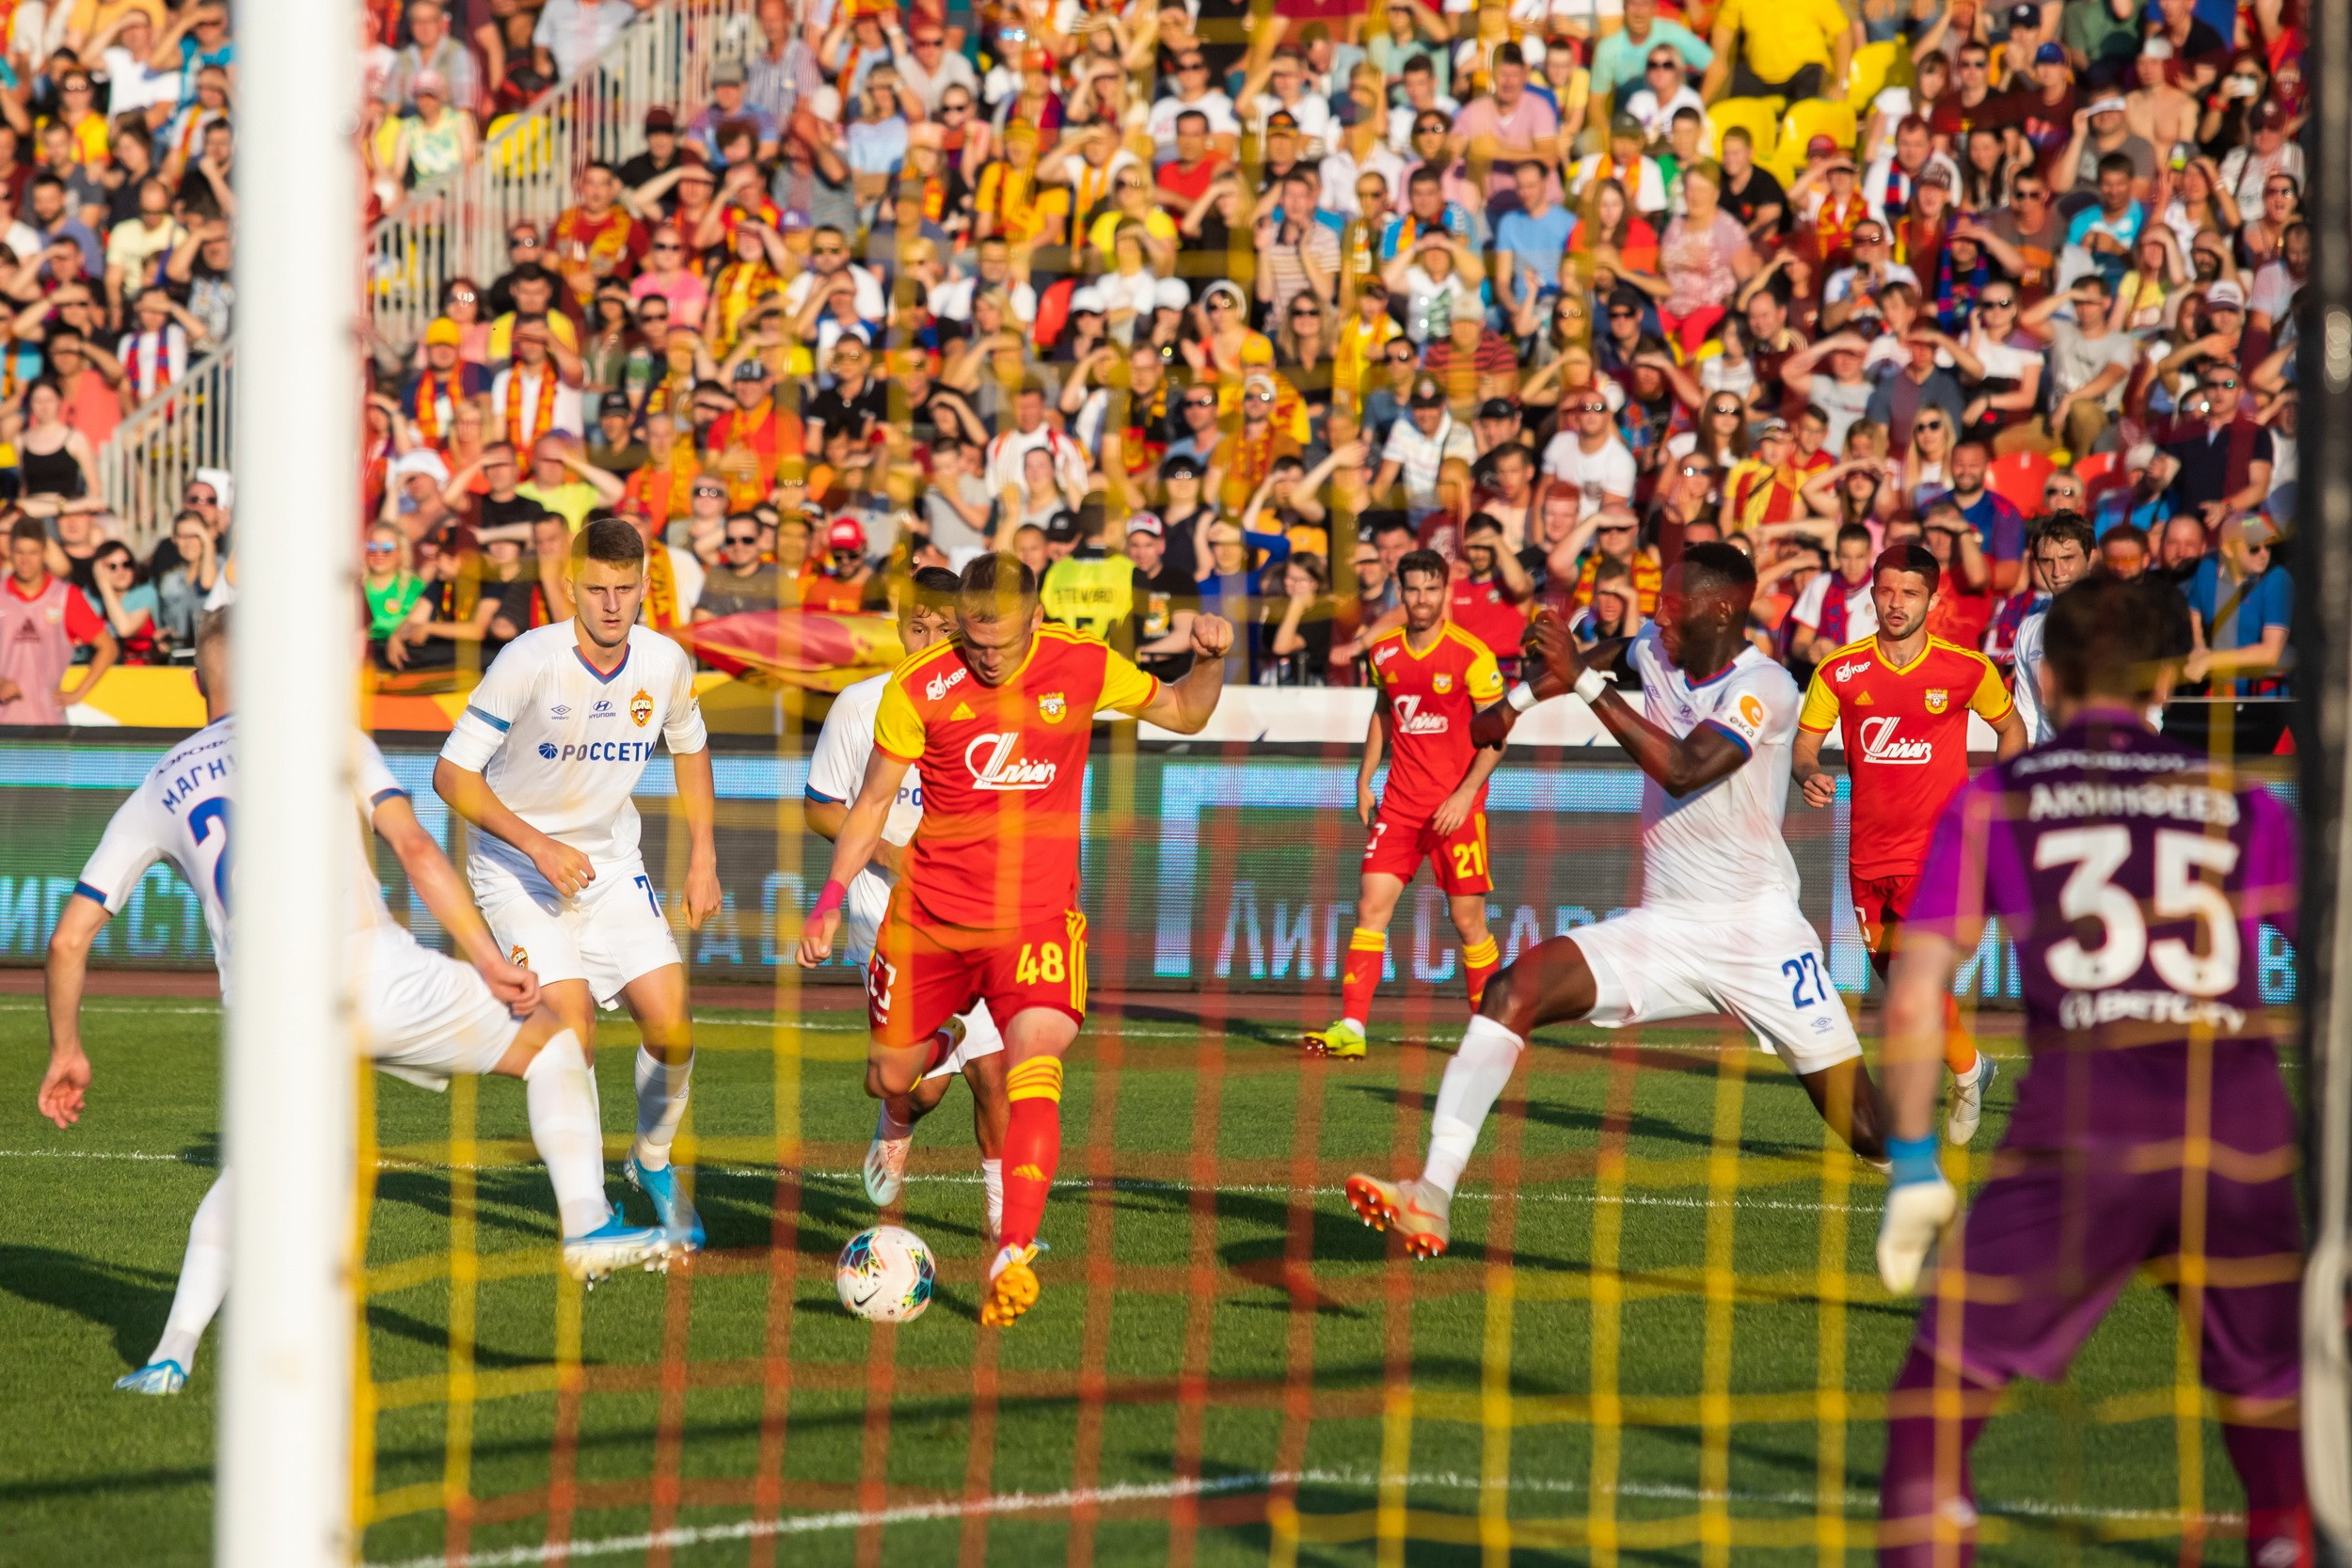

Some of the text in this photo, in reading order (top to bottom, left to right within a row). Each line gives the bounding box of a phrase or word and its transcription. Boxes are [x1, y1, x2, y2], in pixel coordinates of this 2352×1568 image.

[162, 757, 237, 815] МАГН
[1452, 840, 1485, 879] 21
[633, 875, 660, 918] 7
[2034, 823, 2242, 997] 35
[1015, 942, 1067, 986] 48
[1782, 952, 1829, 1010] 27
